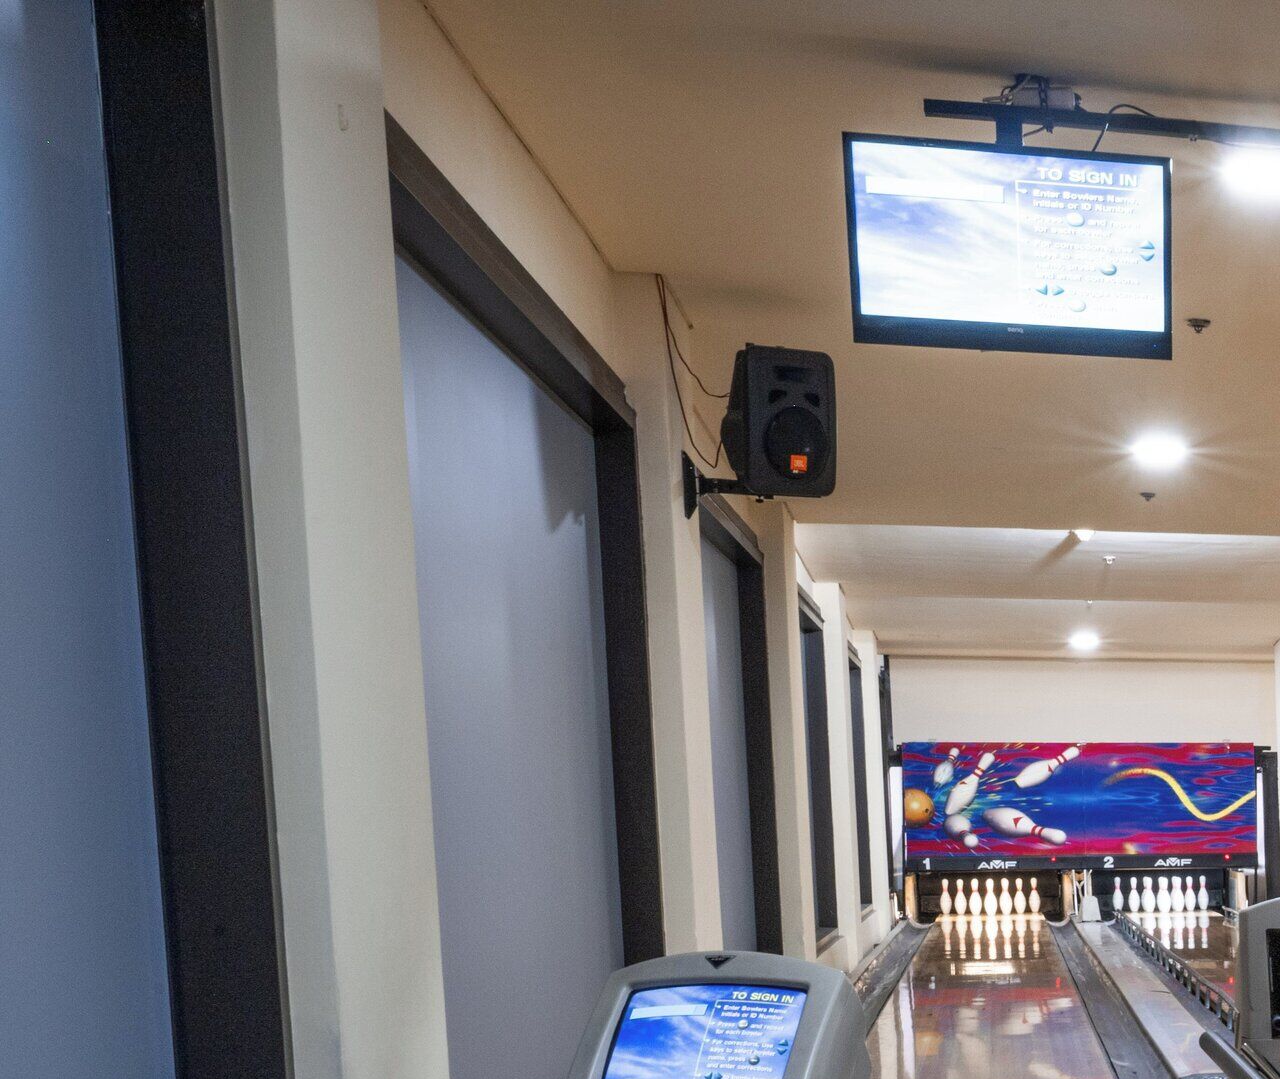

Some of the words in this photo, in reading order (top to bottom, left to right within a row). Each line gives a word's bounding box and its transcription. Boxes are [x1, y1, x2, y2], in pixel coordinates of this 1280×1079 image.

[1037, 167, 1062, 180] TO
[1069, 170, 1112, 184] SIGN
[1120, 173, 1137, 186] IN
[1033, 189, 1060, 198] Enter
[923, 858, 931, 870] 1
[977, 860, 1017, 870] AMF
[1104, 856, 1114, 868] 2
[1154, 857, 1192, 867] AMF
[732, 991, 747, 999] TO
[750, 992, 779, 1002] SIGN
[781, 995, 795, 1003] IN
